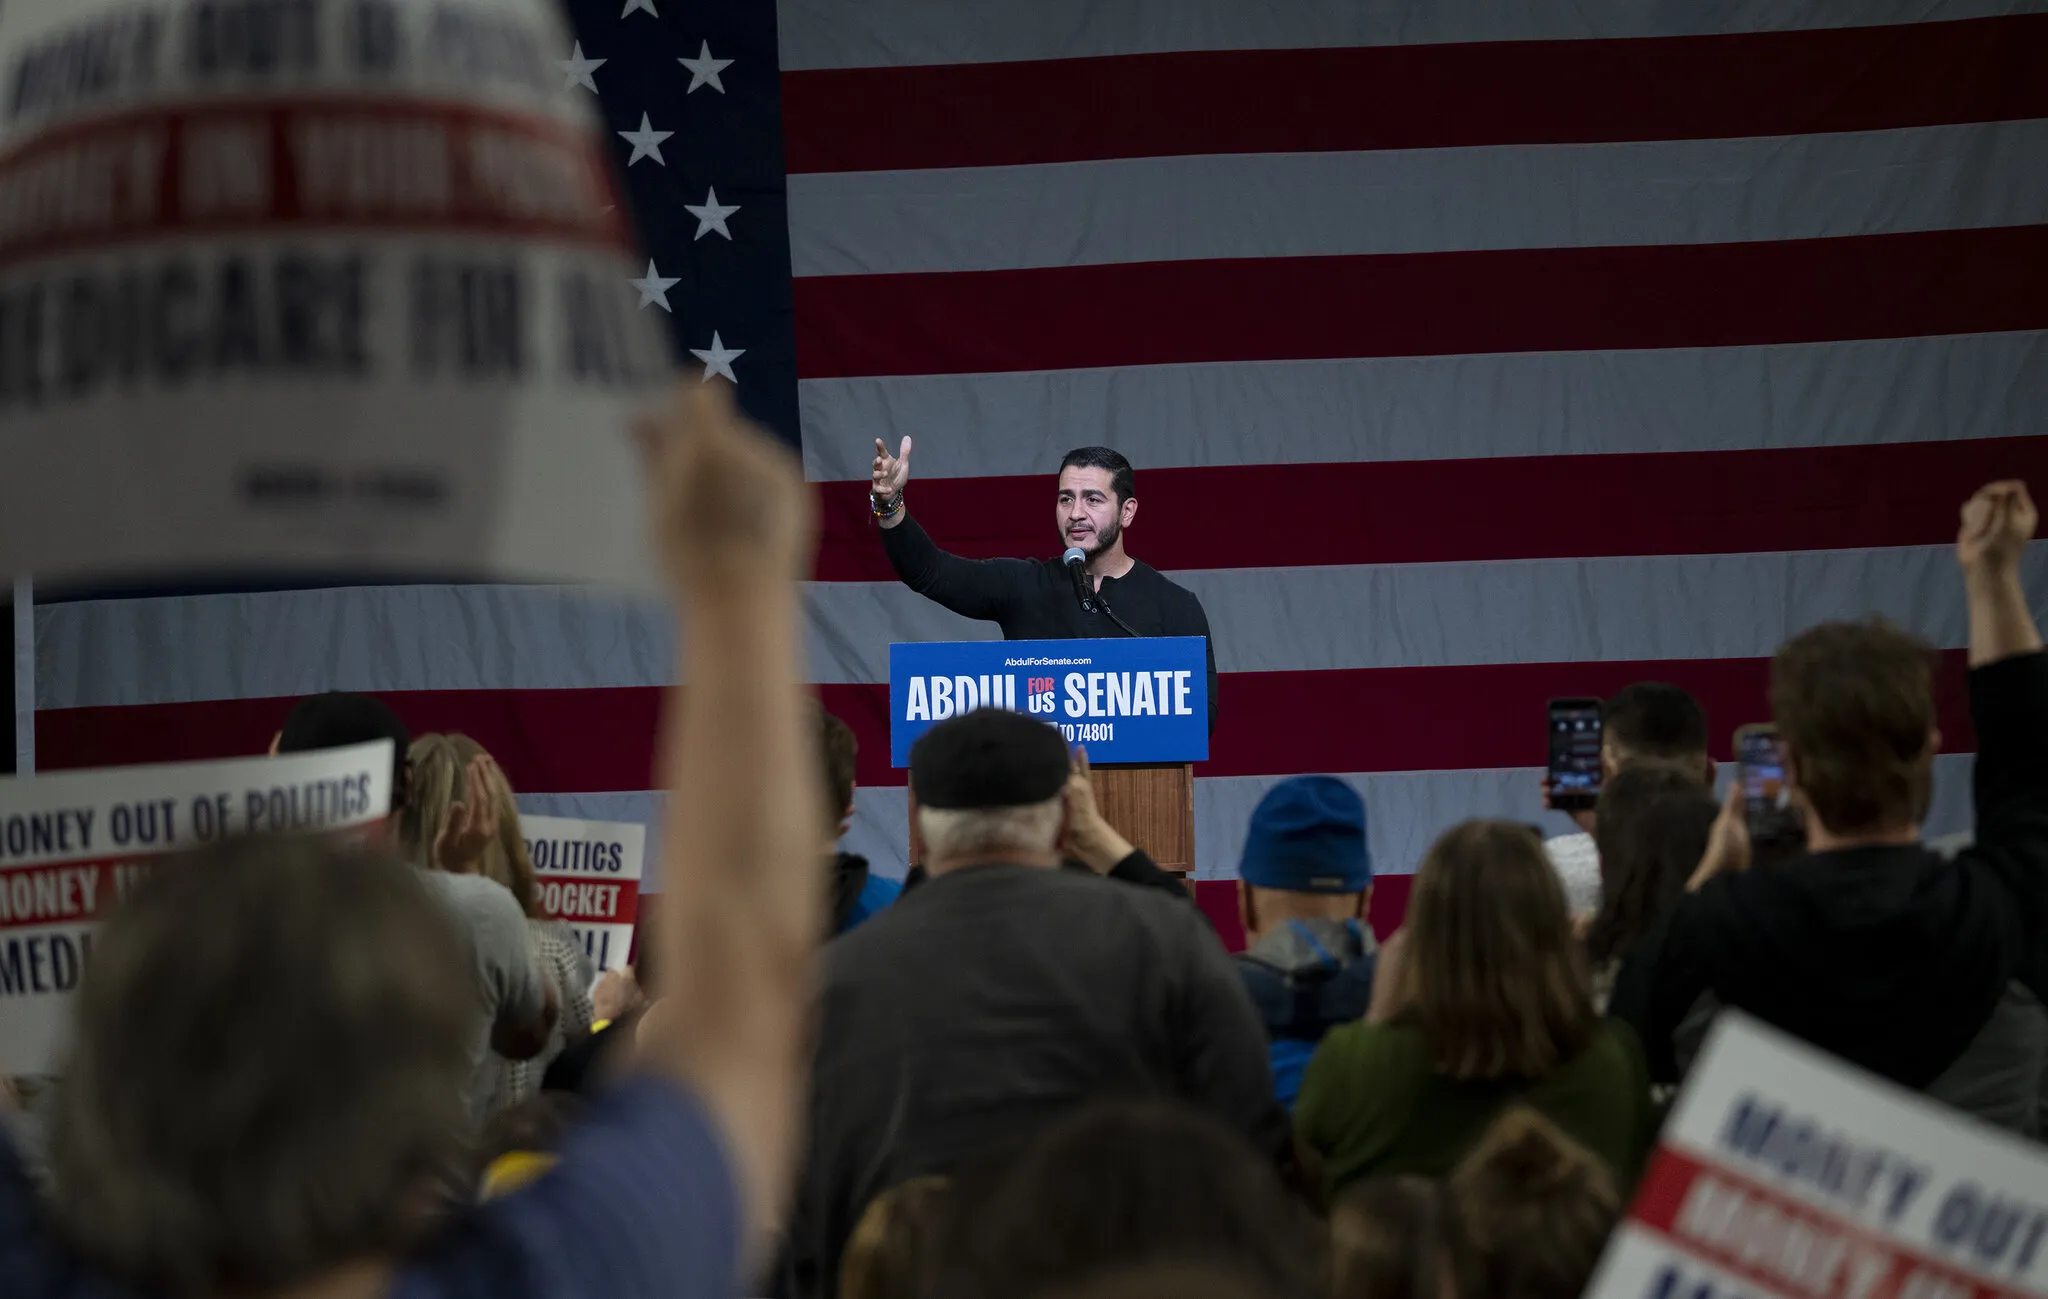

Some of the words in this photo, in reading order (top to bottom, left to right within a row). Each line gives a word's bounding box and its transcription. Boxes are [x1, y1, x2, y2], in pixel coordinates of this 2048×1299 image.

[1005, 657, 1092, 666] AbdulForSenate.com
[1028, 677, 1055, 694] FOR
[1064, 671, 1192, 718] SENATE
[906, 674, 1022, 720] ABDUL
[1028, 692, 1055, 713] US
[1059, 724, 1074, 742] TO
[1076, 723, 1114, 741] 74801
[0, 810, 96, 858] ONEY
[110, 800, 178, 846] OUT
[191, 793, 230, 842] OF
[244, 771, 372, 834] POLITICS
